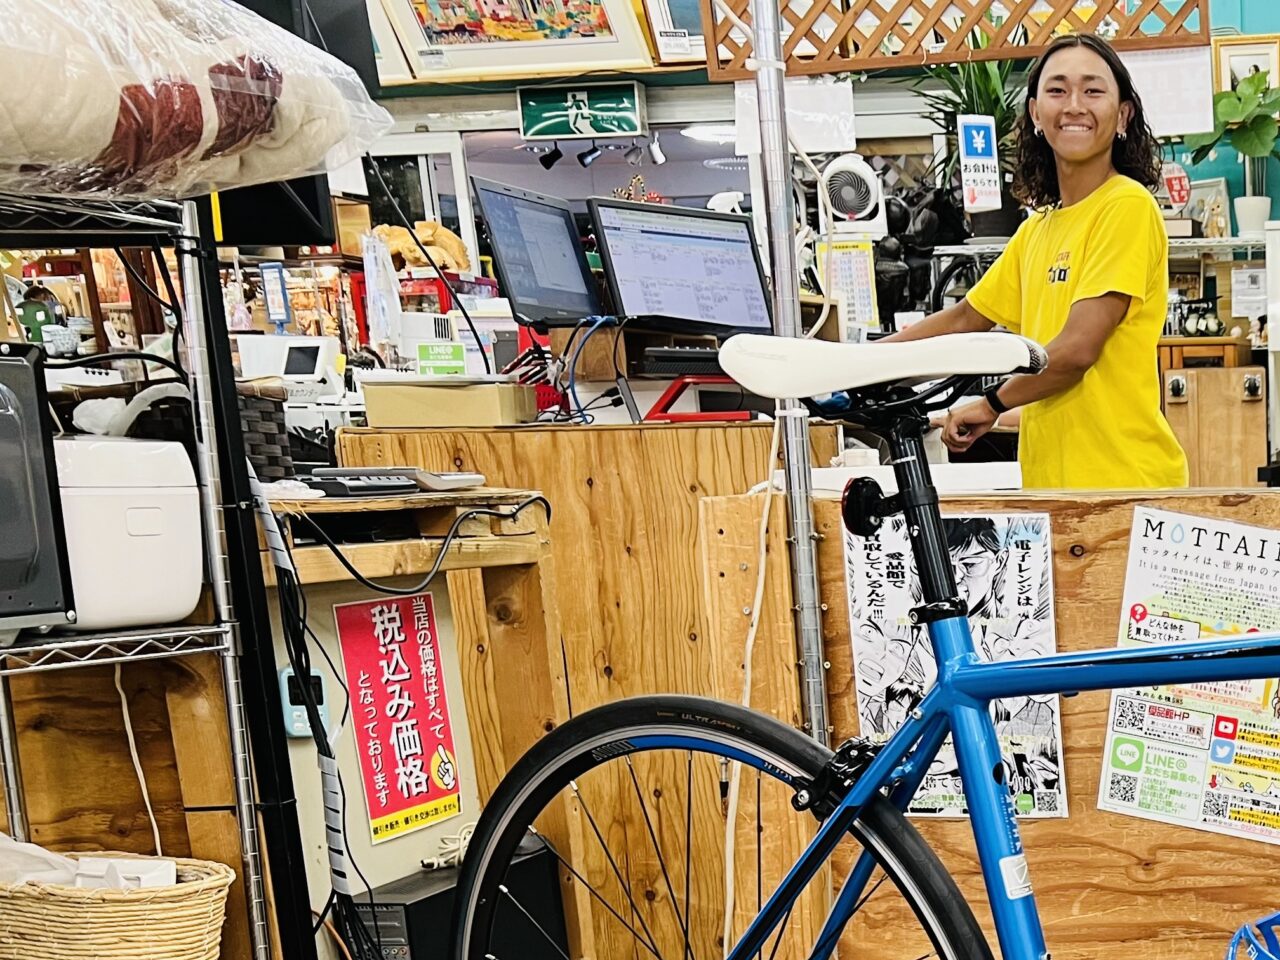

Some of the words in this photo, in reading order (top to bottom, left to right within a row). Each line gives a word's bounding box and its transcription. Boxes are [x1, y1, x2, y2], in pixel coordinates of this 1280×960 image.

[963, 163, 998, 174] お会計は
[964, 179, 998, 187] こちらです
[884, 551, 906, 589] 愛品館で
[1014, 538, 1035, 607] 電子レンジは
[1171, 566, 1211, 581] message
[1214, 573, 1235, 585] from
[1239, 577, 1265, 592] Japan
[1269, 583, 1278, 592] to
[412, 596, 446, 740] 当店の価格はすべて
[370, 602, 430, 800] 税込み価格
[356, 670, 391, 809] となっております
[1119, 748, 1136, 759] LINE
[1145, 751, 1188, 771] LINE@
